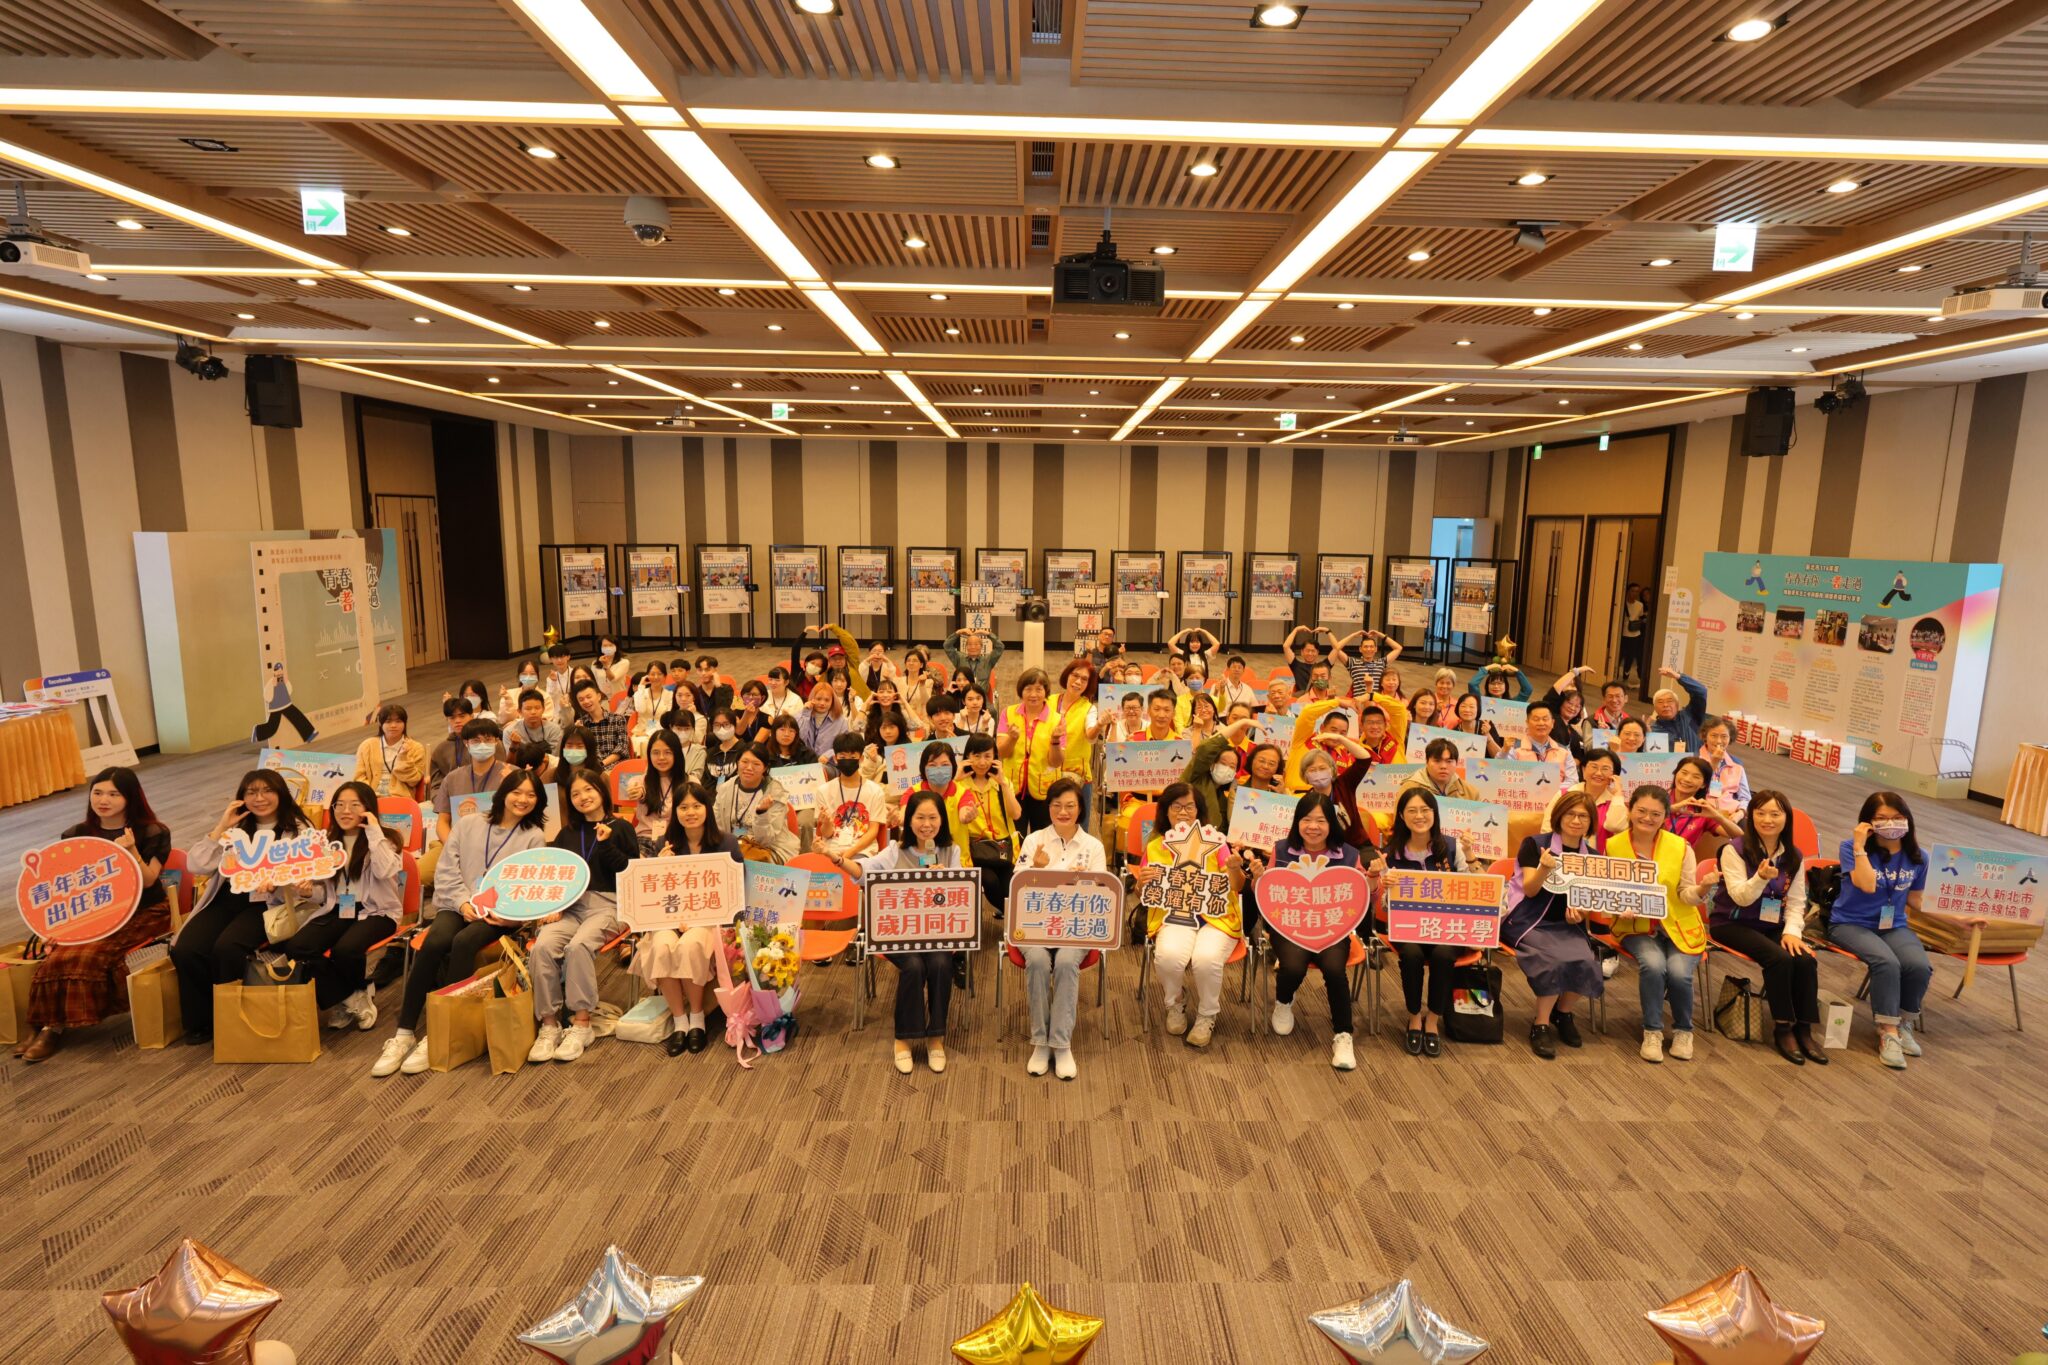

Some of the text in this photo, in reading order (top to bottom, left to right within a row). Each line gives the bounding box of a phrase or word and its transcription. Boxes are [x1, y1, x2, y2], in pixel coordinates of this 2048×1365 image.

[1498, 788, 1528, 799] 新北市
[233, 830, 314, 869] V世代
[29, 852, 123, 908] 青年志工
[233, 855, 338, 892] 兒少志工營
[498, 861, 578, 884] 勇敢挑戰
[640, 869, 722, 894] 青春有你
[1147, 864, 1229, 893] 青春有影
[1561, 854, 1657, 884] 青銀同行
[506, 882, 567, 903] 不放棄
[876, 886, 970, 909] 青春鏡頭
[1142, 885, 1226, 915] 榮耀有你
[1269, 883, 1354, 906] 微笑服務
[1398, 876, 1496, 902] 青銀相遇
[1940, 883, 2033, 905] 社團法人新北市
[45, 882, 113, 928] 出任務
[1023, 890, 1112, 914] 青春有你
[1569, 886, 1665, 918] 時光共鳴
[1937, 897, 2031, 920] 國際生命線協會
[876, 912, 970, 937] 歲月同行
[1022, 914, 1110, 939] 一耆走過
[1280, 906, 1345, 928] 超有愛
[1394, 917, 1494, 942] 一路共學
